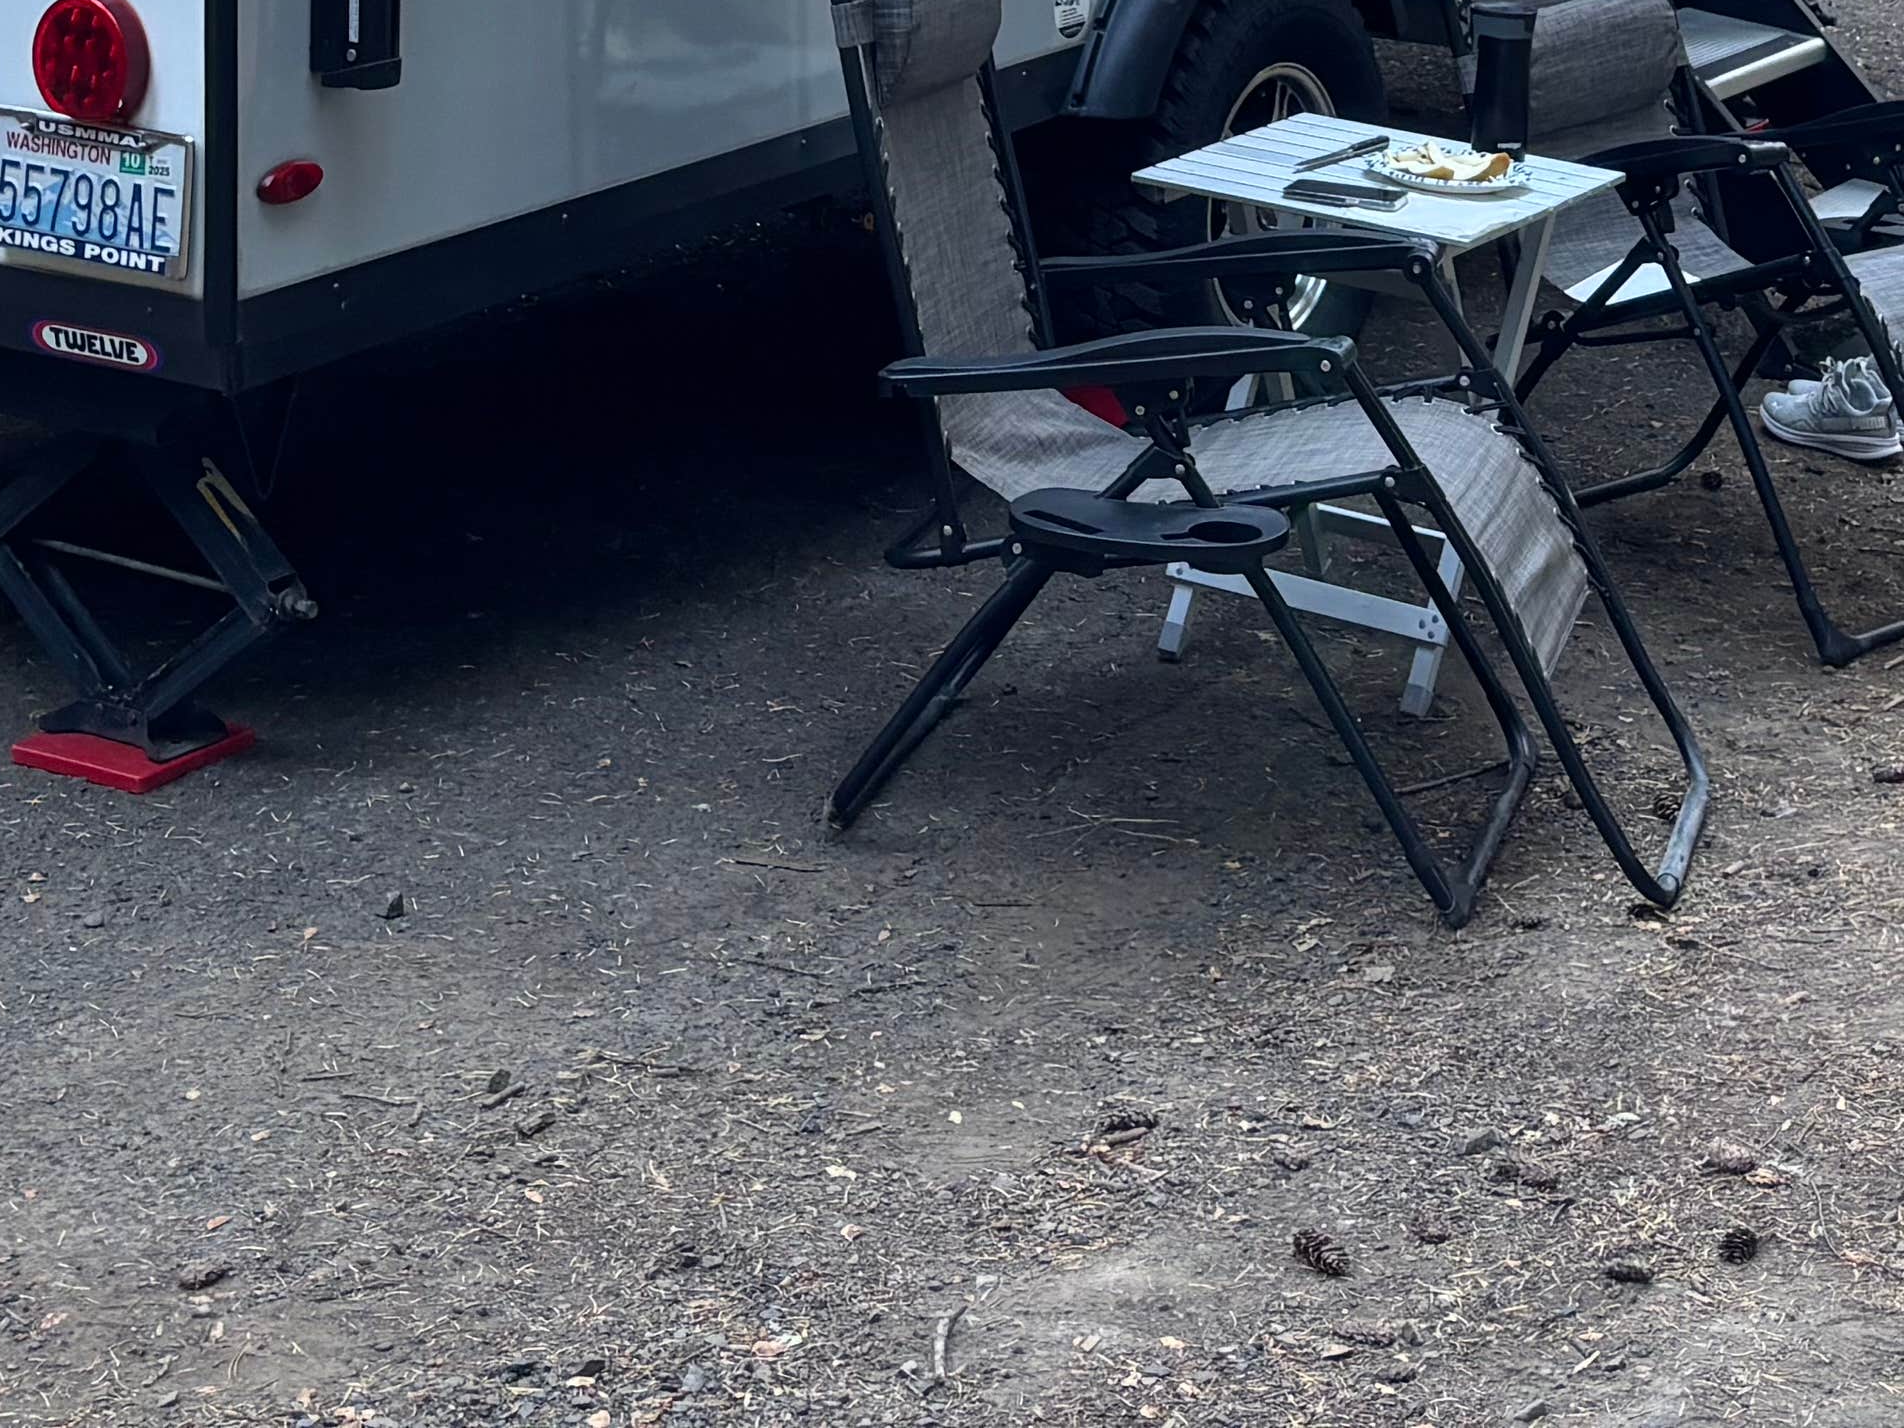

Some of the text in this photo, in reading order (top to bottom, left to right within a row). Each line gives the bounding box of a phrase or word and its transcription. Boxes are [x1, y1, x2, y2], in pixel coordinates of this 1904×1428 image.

[38, 120, 138, 147] USMMA
[6, 131, 112, 166] WASHINGTON
[122, 151, 141, 169] 10
[84, 244, 166, 273] POINT
[49, 326, 140, 363] TWELVE
